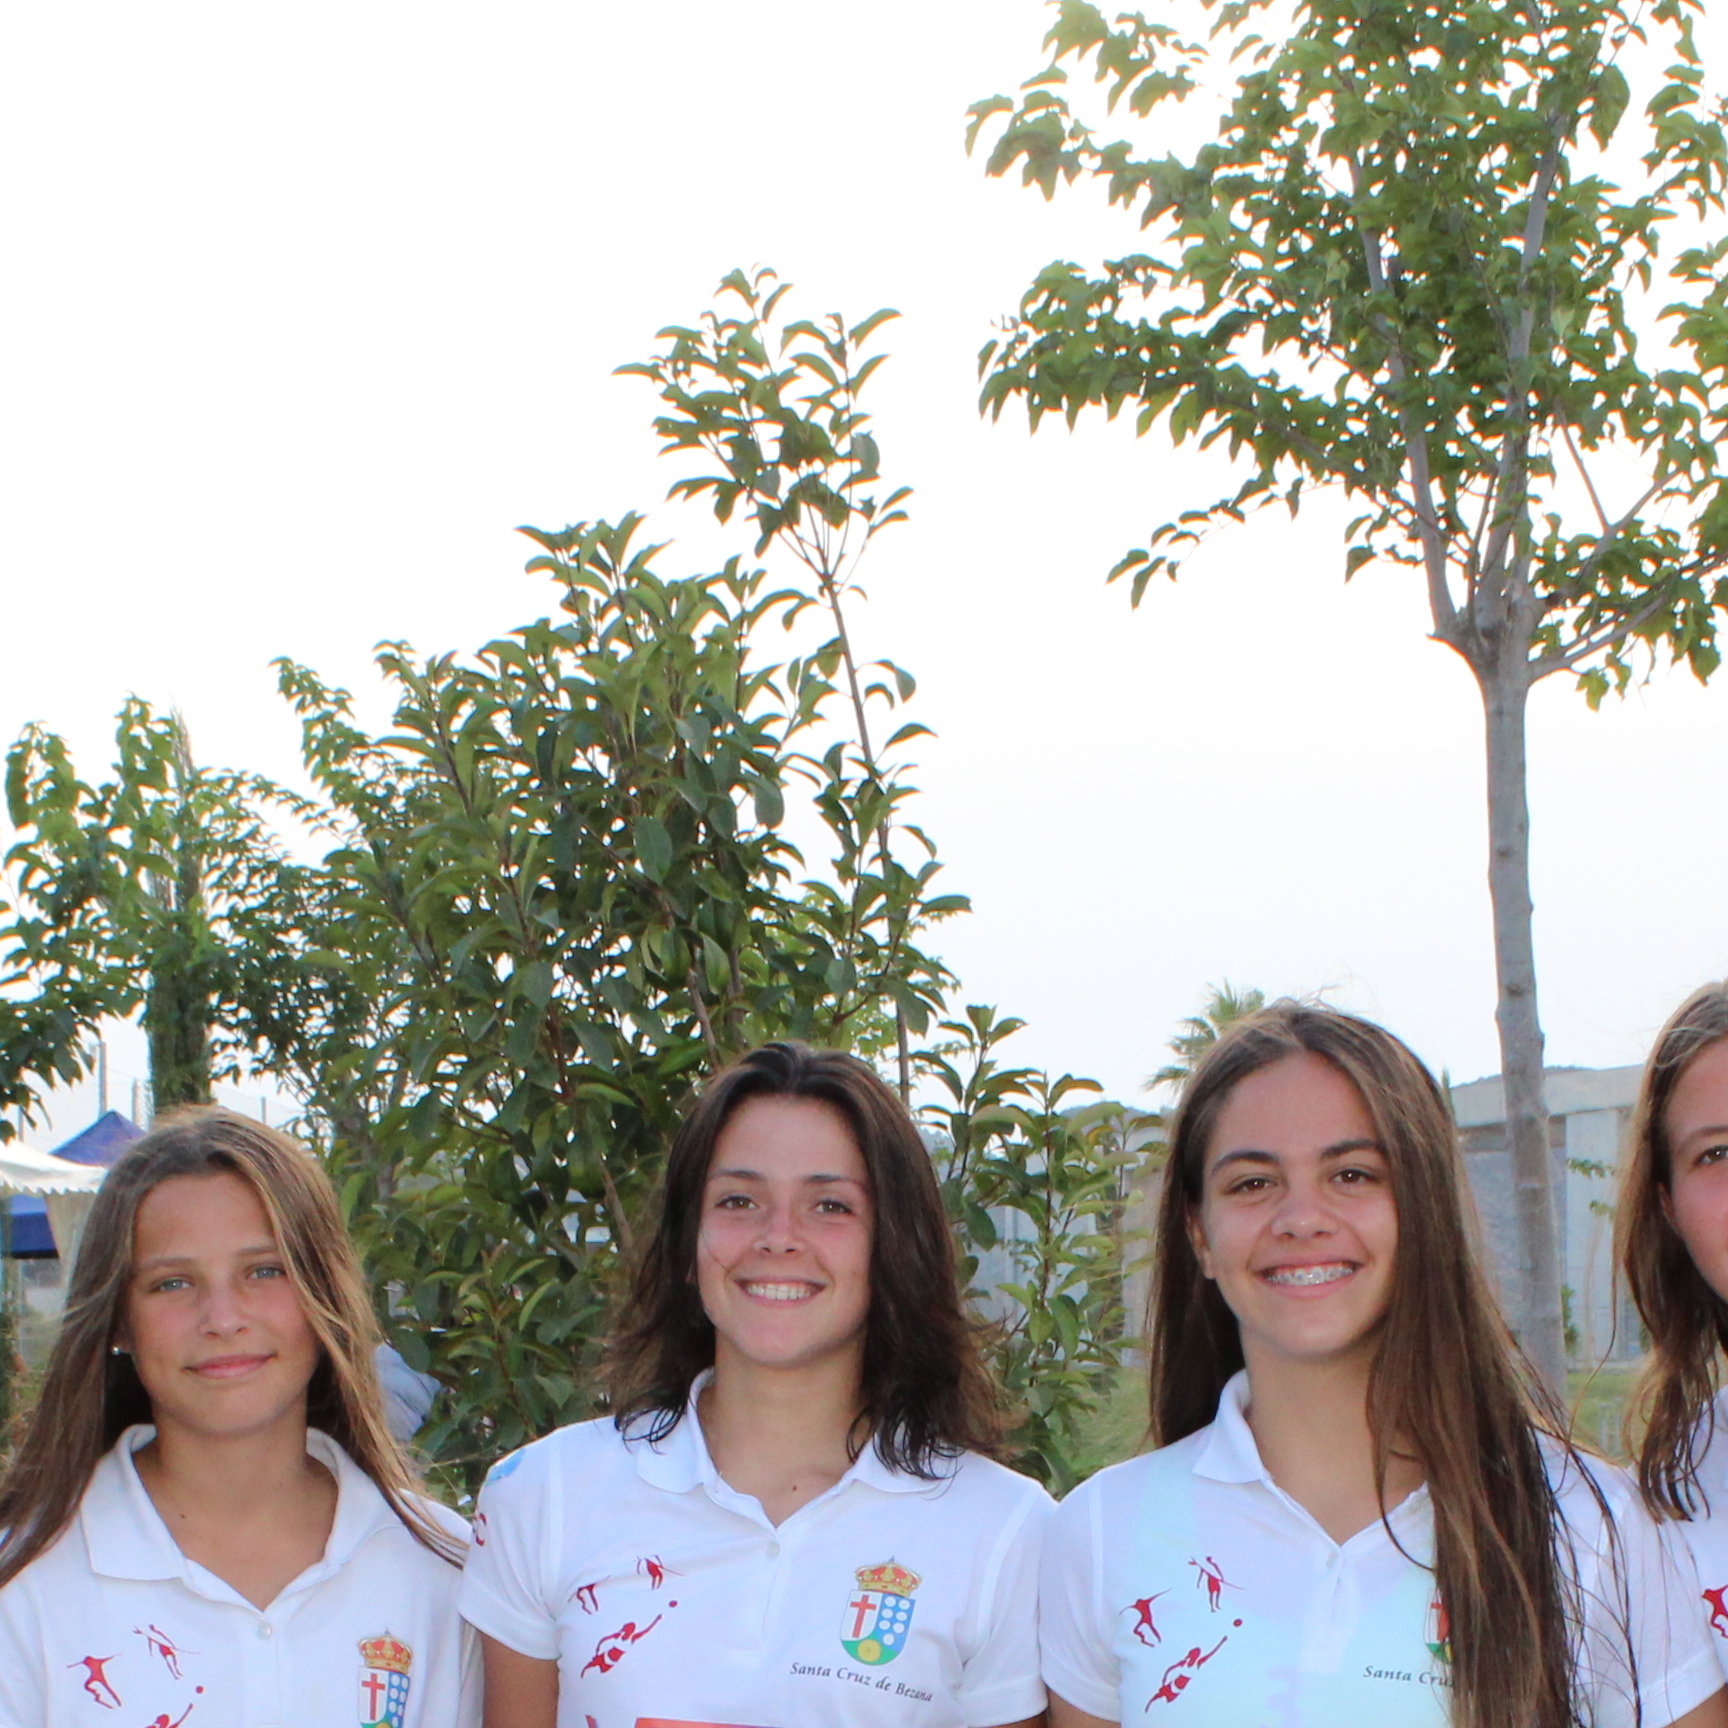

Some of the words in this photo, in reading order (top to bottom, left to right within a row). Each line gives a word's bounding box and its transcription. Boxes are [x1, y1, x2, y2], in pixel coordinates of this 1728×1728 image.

[789, 1662, 831, 1679] Santa
[836, 1666, 871, 1687] Cruz
[876, 1673, 891, 1693] de
[894, 1680, 933, 1702] Bezana
[1363, 1665, 1412, 1682] Santa
